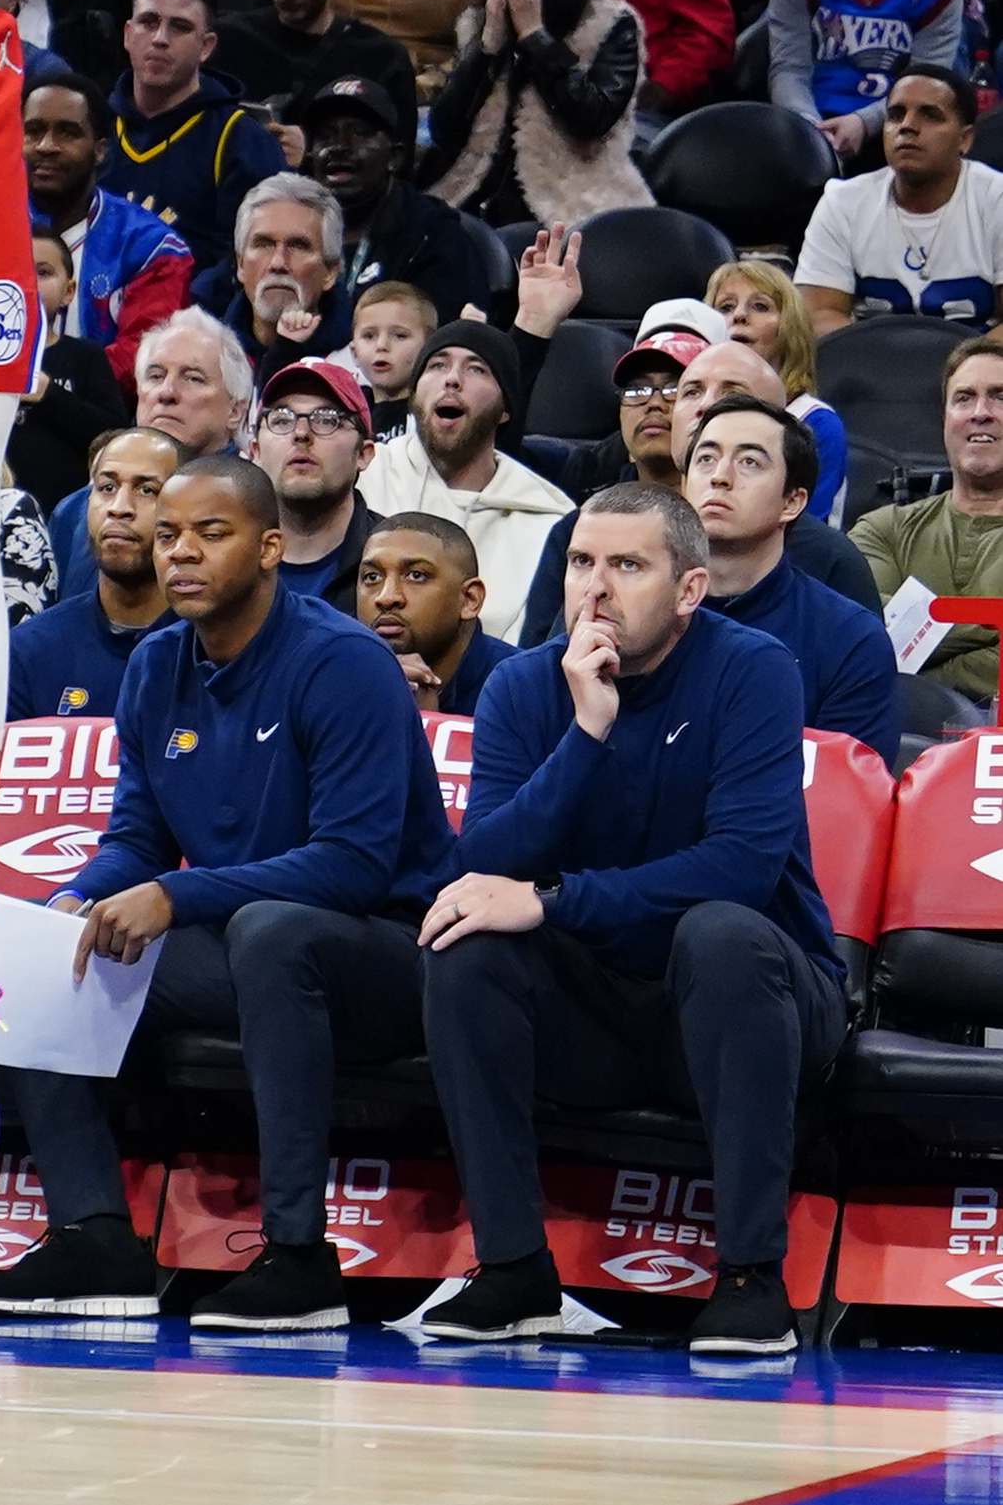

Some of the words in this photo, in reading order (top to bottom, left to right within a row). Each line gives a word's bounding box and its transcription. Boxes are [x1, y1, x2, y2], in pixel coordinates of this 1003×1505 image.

[324, 1157, 390, 1200] IO
[325, 1204, 384, 1226] EEL
[604, 1216, 716, 1247] STEEL
